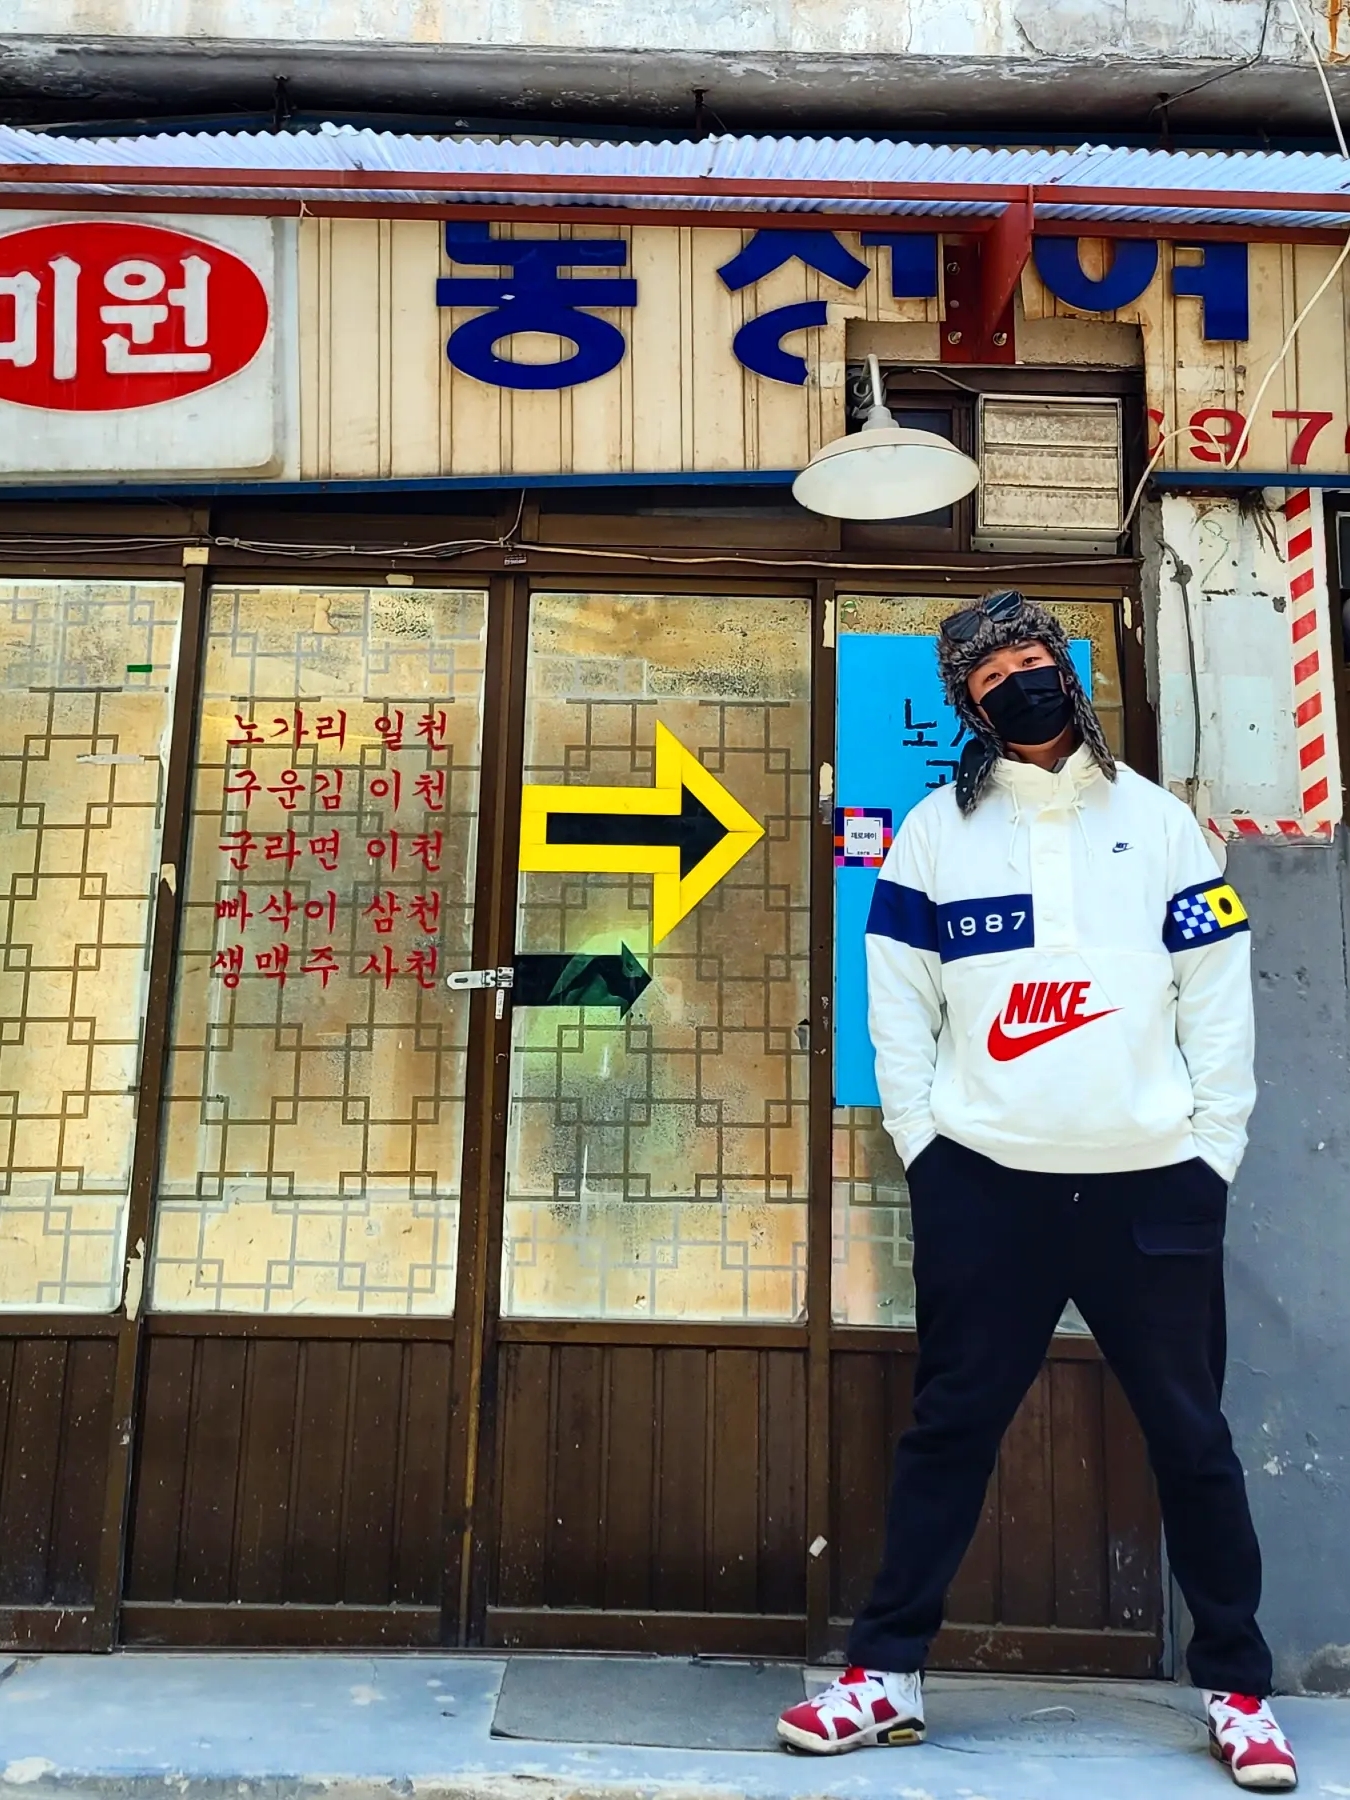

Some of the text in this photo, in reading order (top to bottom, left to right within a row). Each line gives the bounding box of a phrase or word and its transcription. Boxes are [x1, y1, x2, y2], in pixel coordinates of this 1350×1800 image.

[0, 254, 212, 380] 미원
[227, 709, 447, 751] 노가리 일천
[223, 769, 444, 812] 구운김 이천
[219, 829, 442, 873] 군라면 이천
[214, 889, 441, 934] 빠삭이 삼천
[946, 910, 1027, 940] 1987
[210, 943, 439, 990] 생맥주 사천
[1004, 981, 1091, 1026] NIKE
